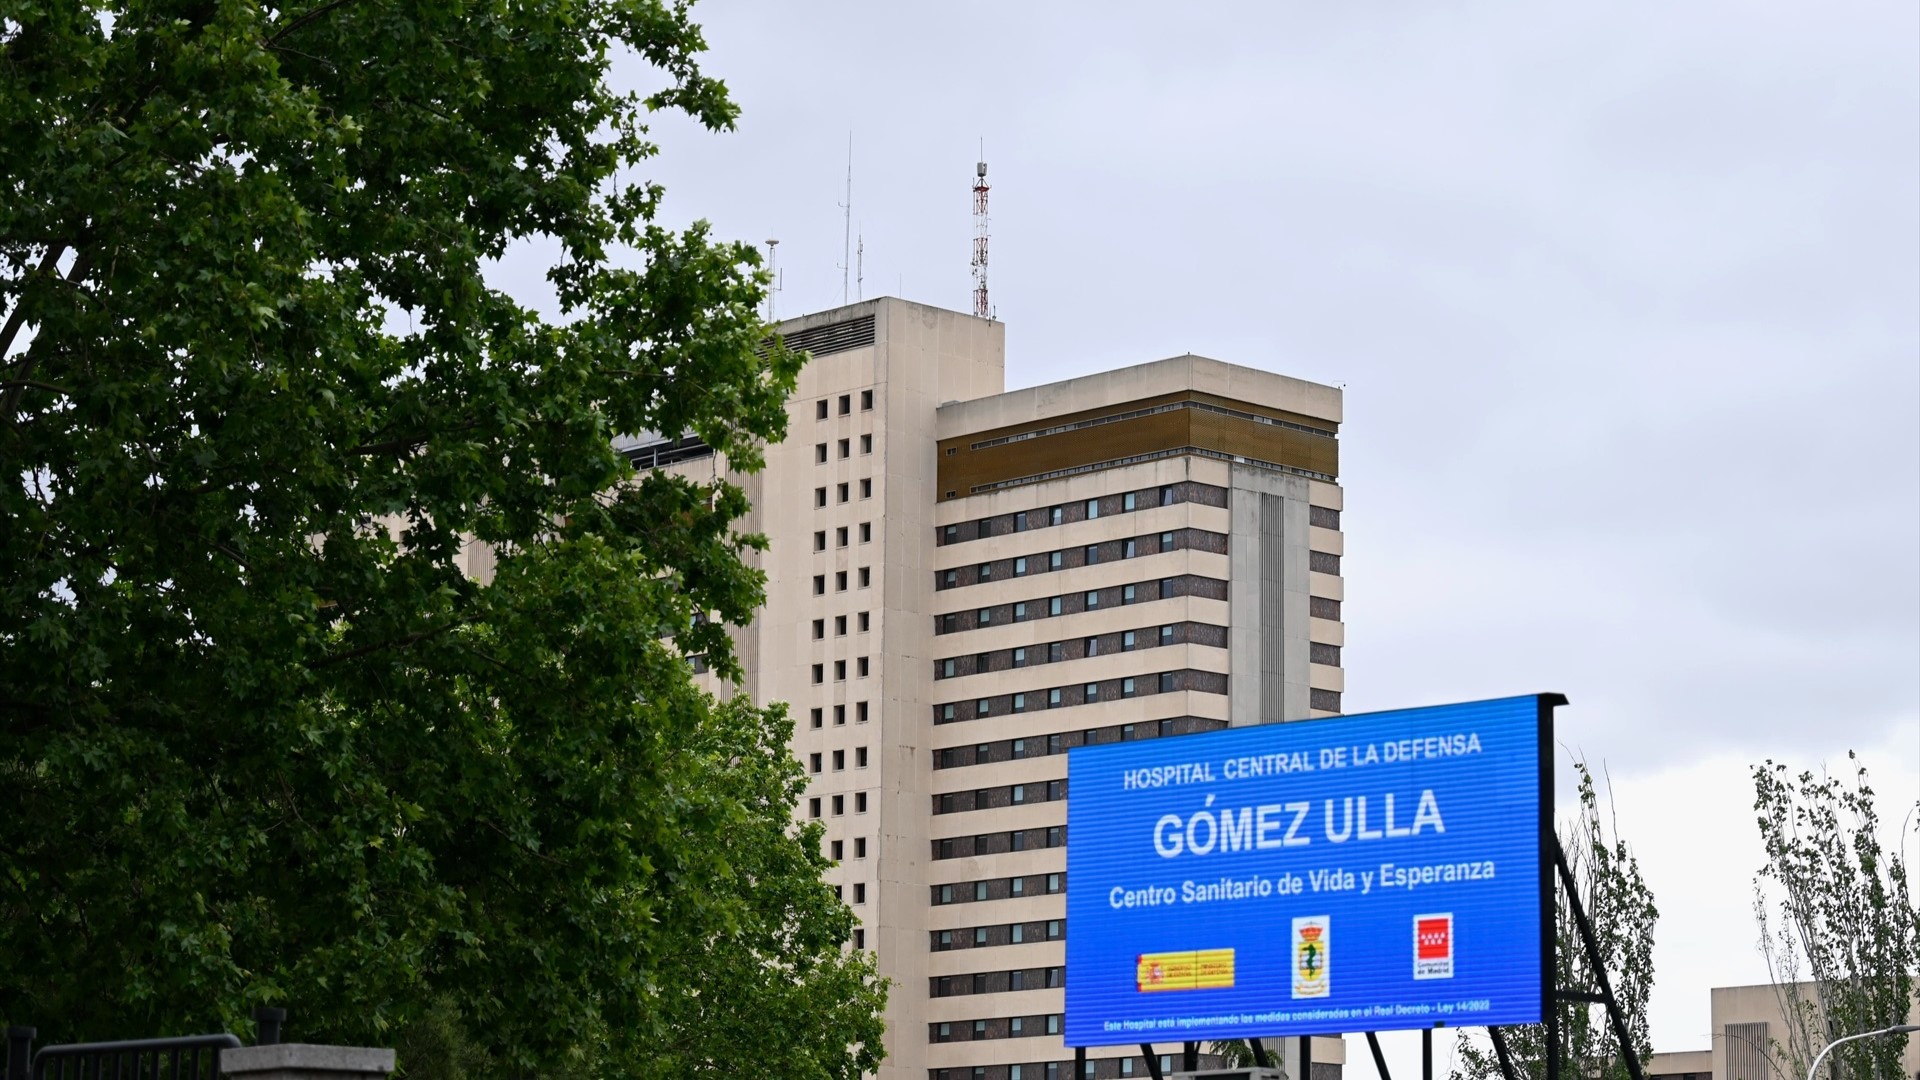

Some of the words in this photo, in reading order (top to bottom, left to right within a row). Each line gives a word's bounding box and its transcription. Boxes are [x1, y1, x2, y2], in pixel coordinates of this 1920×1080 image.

[1123, 762, 1216, 790] HOSPITAL
[1223, 751, 1315, 780] CENTRAL
[1320, 747, 1348, 770] DE
[1353, 744, 1380, 767] LA
[1384, 732, 1483, 763] DEFENSA
[1153, 793, 1311, 858] GÓMEZ
[1324, 789, 1446, 843] ULLA
[1109, 885, 1176, 910] Centro
[1182, 874, 1271, 905] Sanitario
[1277, 872, 1303, 896] de
[1308, 867, 1355, 893] Vida
[1361, 870, 1374, 896] y
[1380, 860, 1496, 890] Esperanza
[1104, 1021, 1121, 1031] Este
[1123, 1018, 1156, 1031] Hospital
[1158, 1018, 1175, 1028] está
[1351, 1007, 1362, 1017] en
[1364, 1005, 1372, 1016] el
[1374, 1004, 1393, 1015] Real
[1396, 1002, 1429, 1014] Decreto
[1437, 1002, 1454, 1014] Ley
